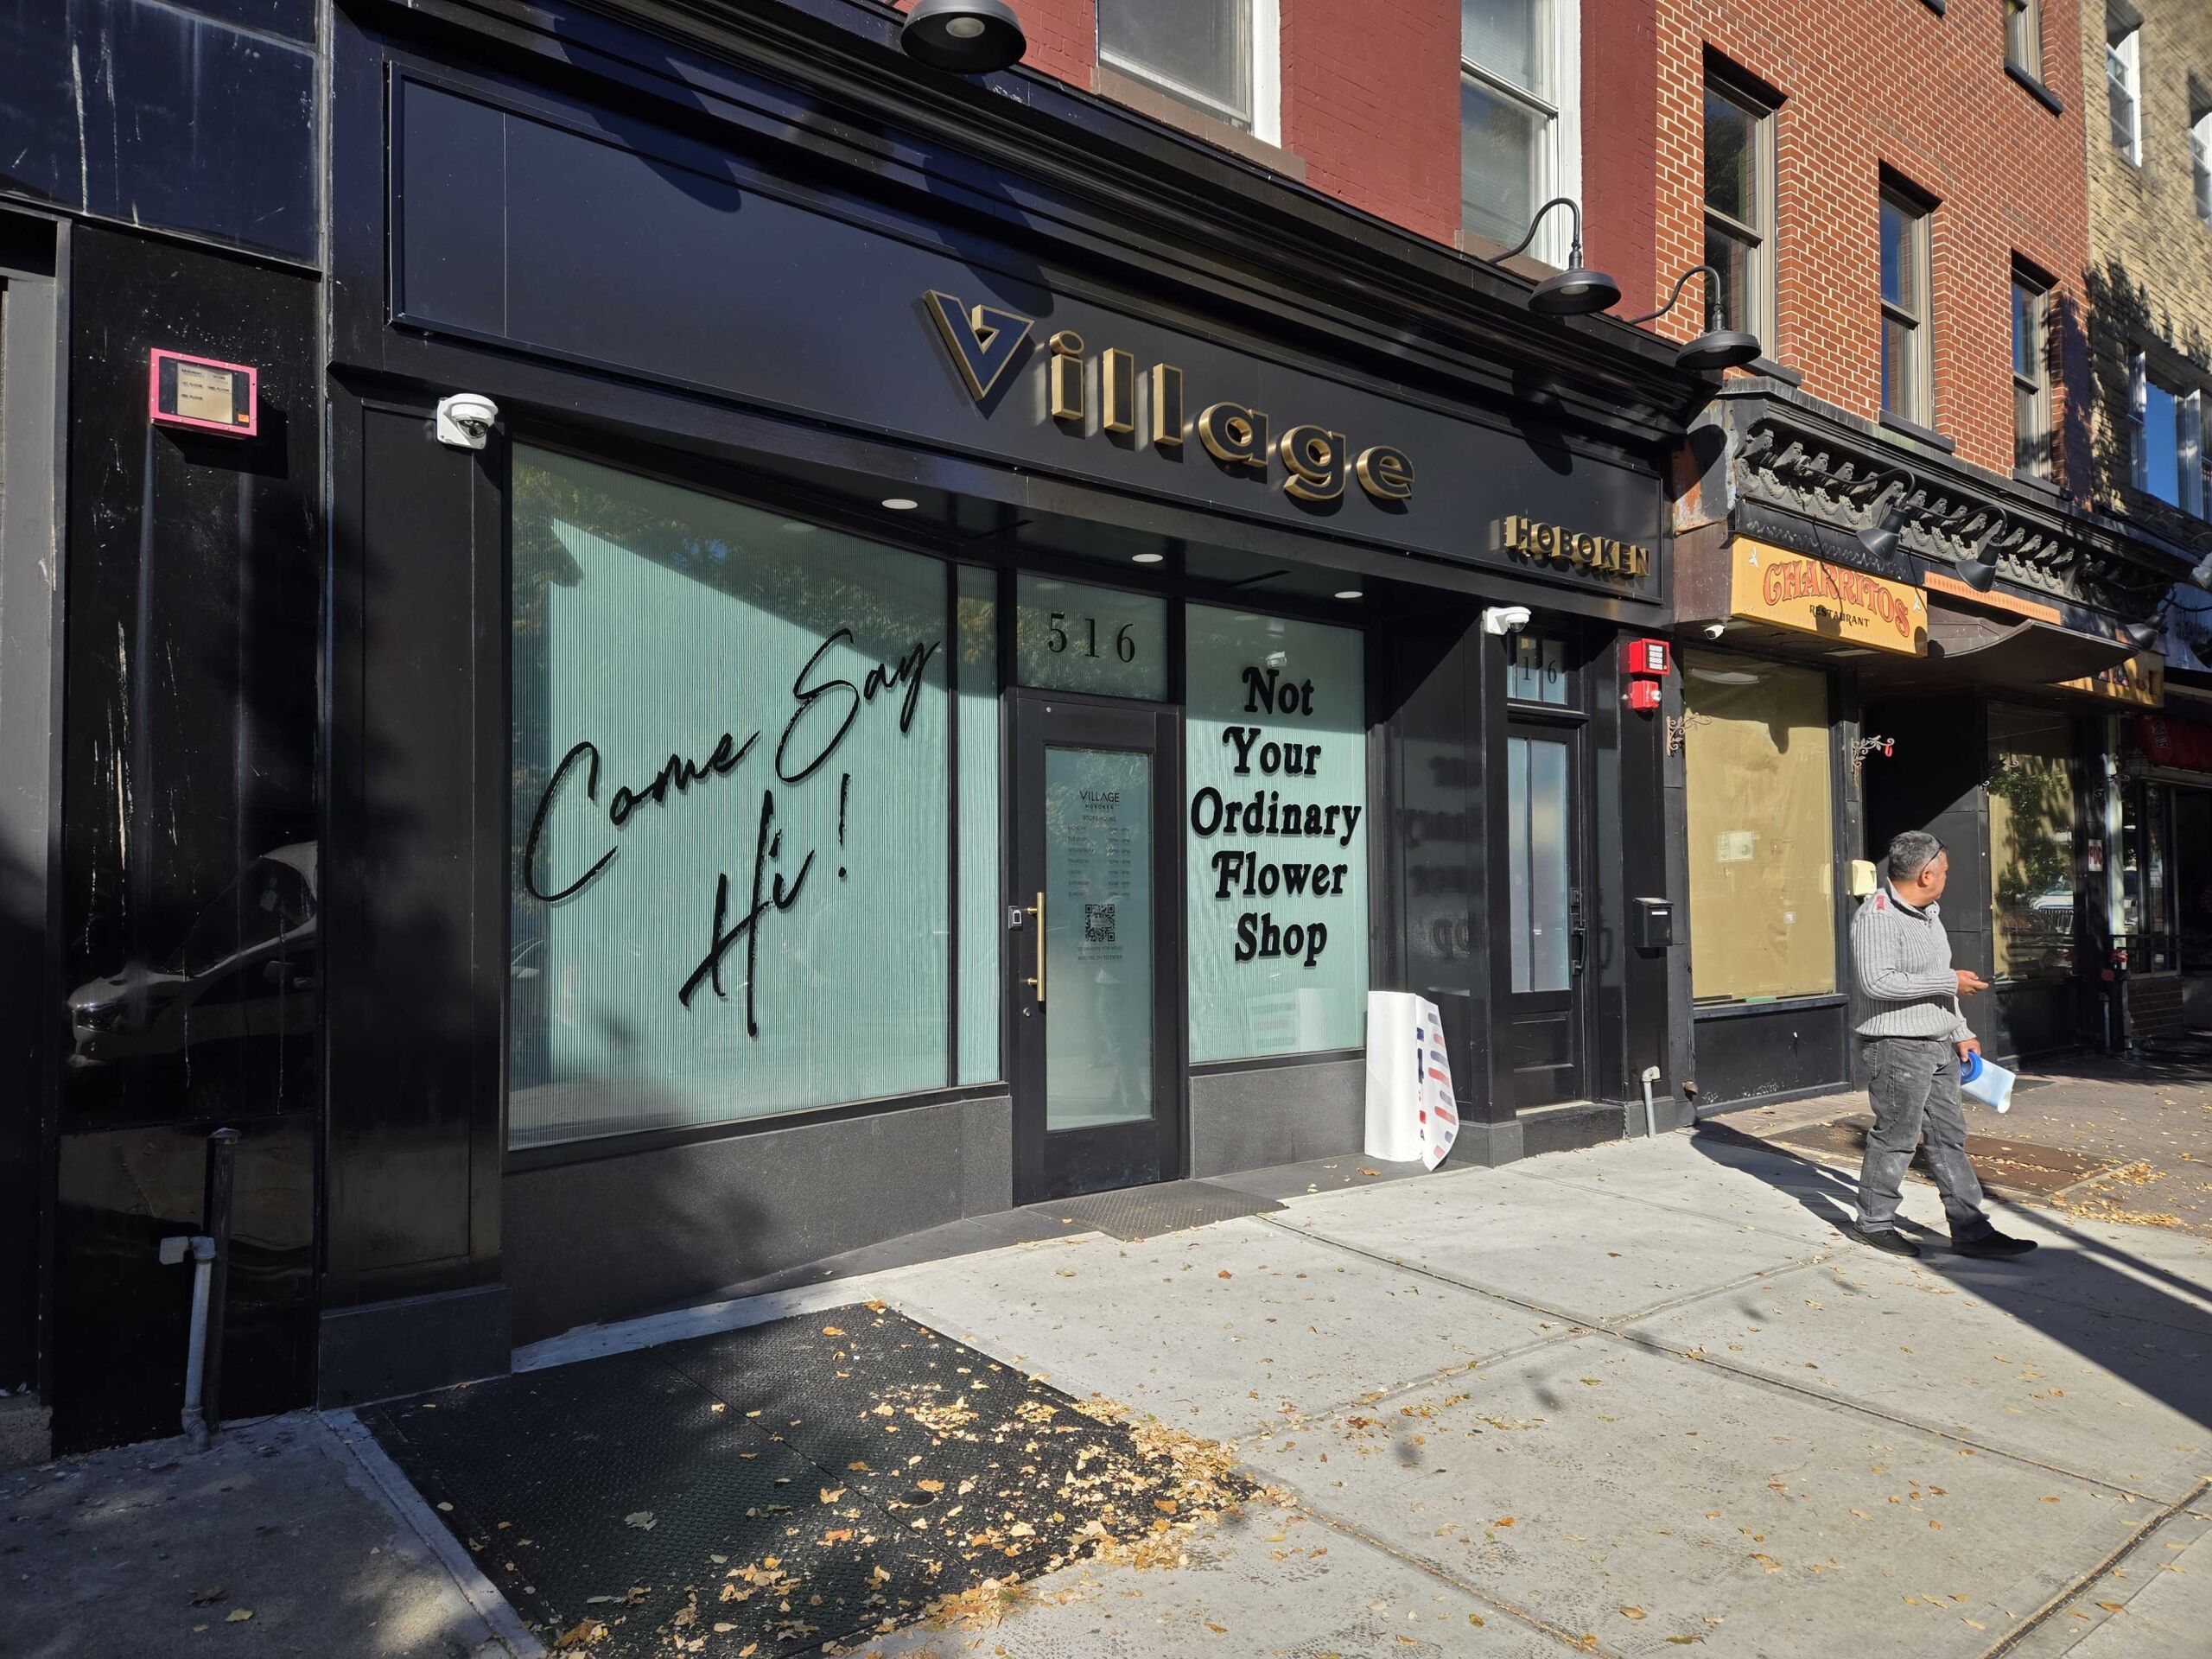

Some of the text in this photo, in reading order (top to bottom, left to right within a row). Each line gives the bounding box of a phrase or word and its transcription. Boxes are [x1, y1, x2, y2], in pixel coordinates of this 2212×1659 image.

[923, 289, 1415, 501] Village
[1504, 515, 1650, 577] HOBOKEN
[1763, 560, 1910, 638] CHARRITOS
[1809, 604, 1870, 628] RESTAURANT
[1048, 613, 1135, 663] 516
[1242, 666, 1315, 716] Not
[524, 628, 940, 903] Come Say
[1222, 726, 1322, 775] Your
[1079, 791, 1120, 803] VILLAGE
[1191, 786, 1362, 848] Ordinary
[1212, 850, 1348, 898] Flower
[1235, 912, 1328, 967] Shop
